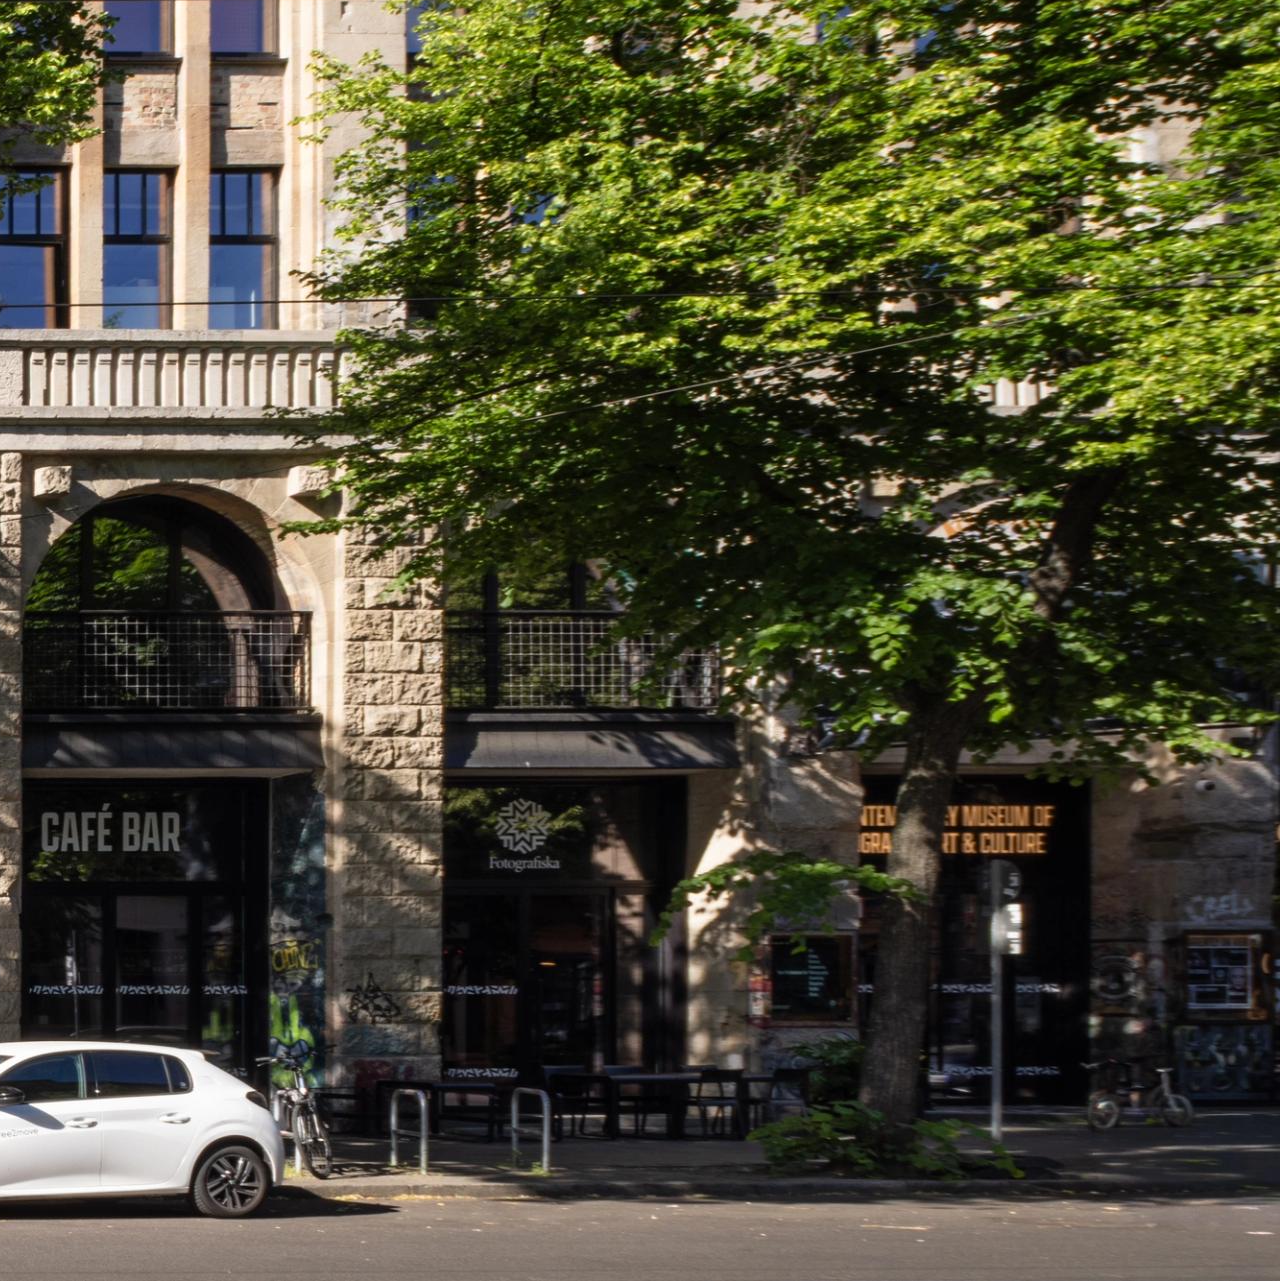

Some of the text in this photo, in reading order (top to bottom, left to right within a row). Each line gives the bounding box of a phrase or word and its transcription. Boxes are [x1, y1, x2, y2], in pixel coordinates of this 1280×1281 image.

[41, 802, 181, 852] CAFÉ BAR
[961, 805, 1030, 827] MUSEUM
[1033, 805, 1056, 827] OF
[961, 832, 977, 854] &
[979, 832, 1048, 854] CULTURE
[489, 855, 561, 873] Fotografiska
